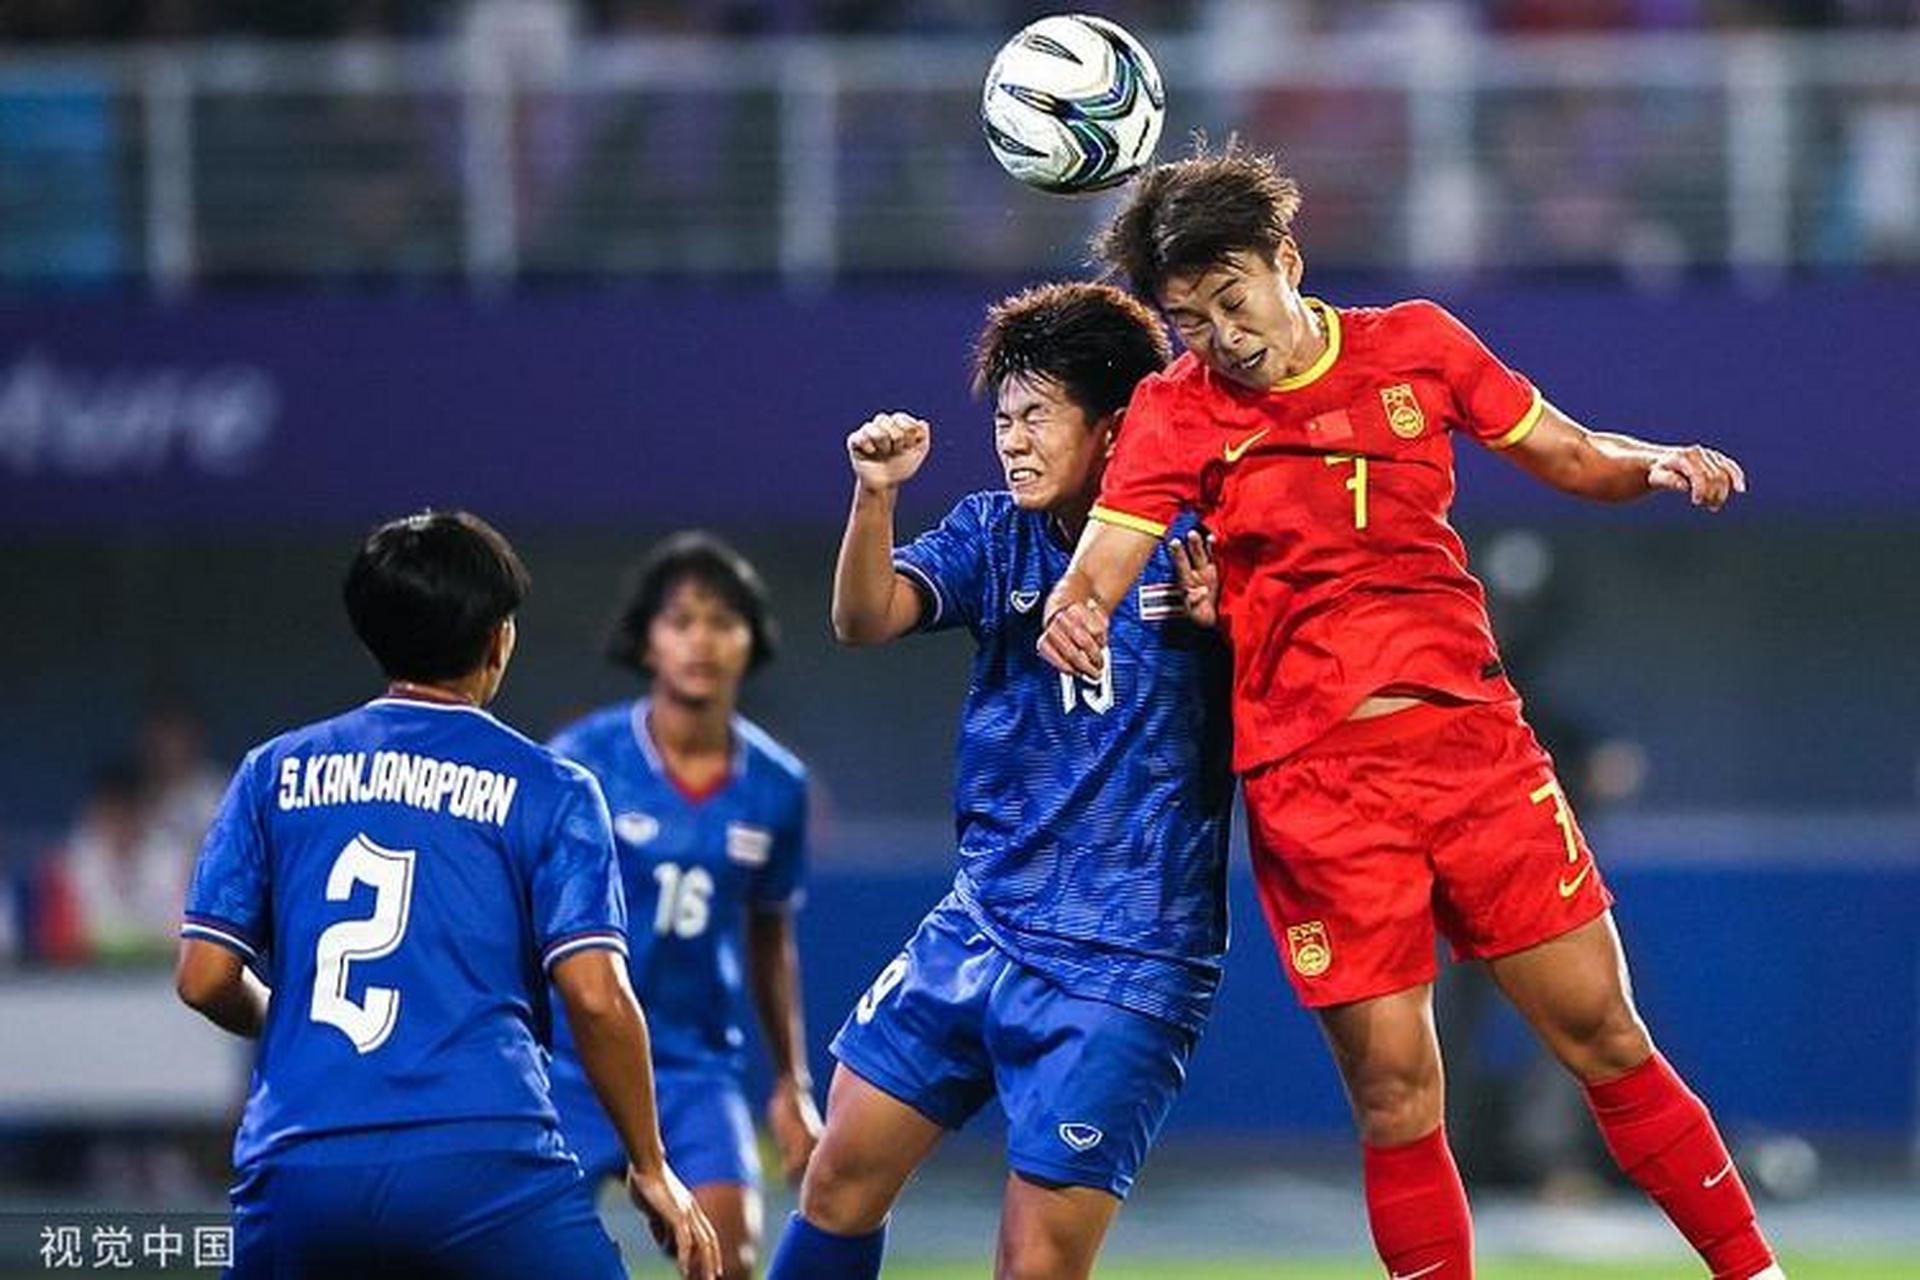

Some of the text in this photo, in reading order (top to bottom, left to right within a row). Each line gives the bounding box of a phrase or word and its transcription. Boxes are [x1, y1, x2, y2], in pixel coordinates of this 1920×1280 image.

[1324, 456, 1368, 530] 7
[278, 751, 518, 827] S.KANJANAPORN
[1529, 779, 1578, 864] 7
[653, 862, 715, 939] 16
[310, 832, 416, 1054] 2
